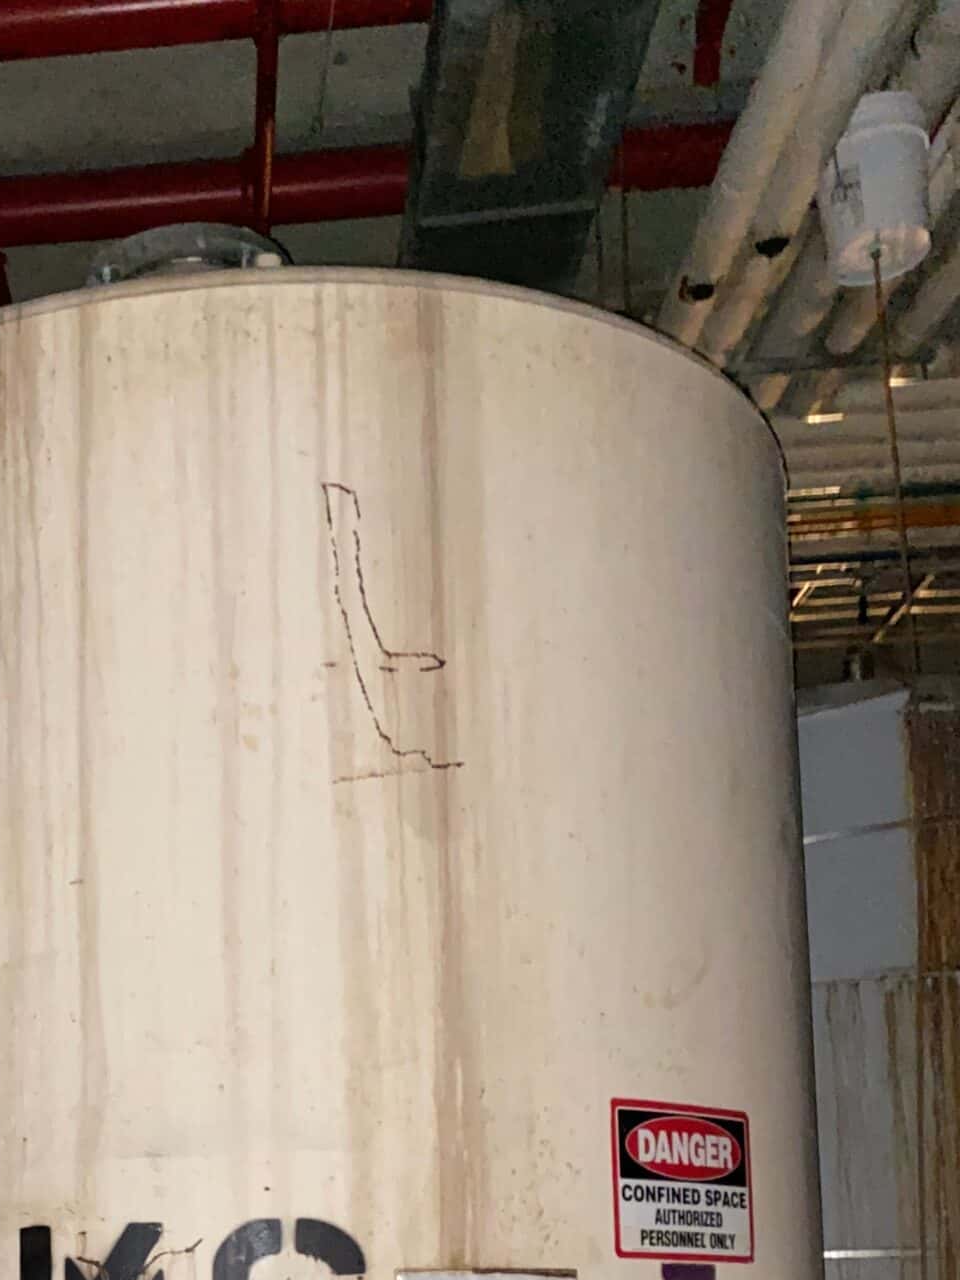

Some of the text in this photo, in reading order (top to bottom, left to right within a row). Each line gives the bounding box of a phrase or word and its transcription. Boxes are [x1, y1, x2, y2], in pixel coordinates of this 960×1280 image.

[637, 1128, 733, 1169] DANGER
[622, 1184, 747, 1209] CONFINED SPACE
[655, 1209, 723, 1228] AUTHORIZED
[641, 1229, 736, 1249] PERSONNEL ONLY
